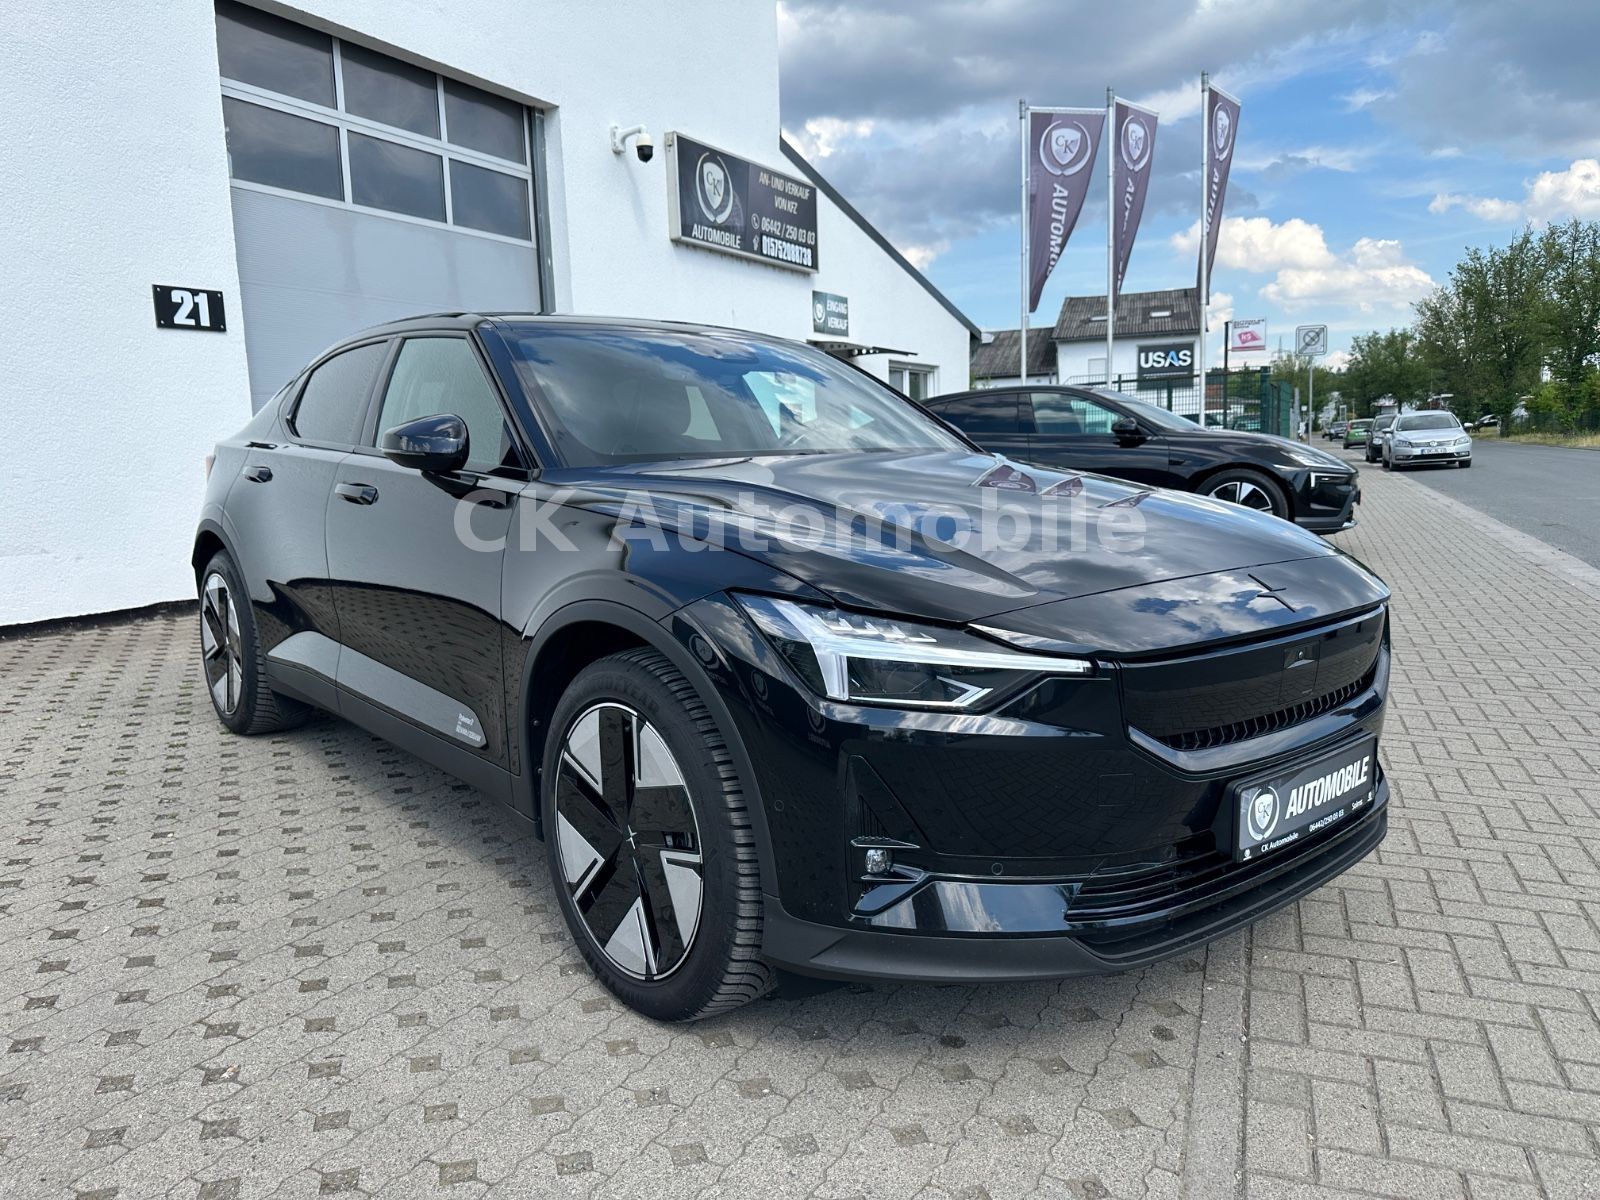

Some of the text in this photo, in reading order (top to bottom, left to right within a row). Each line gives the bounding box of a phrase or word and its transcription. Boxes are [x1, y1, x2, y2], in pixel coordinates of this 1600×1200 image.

[691, 223, 742, 249] AUTOMOBILE
[171, 289, 211, 327] 21
[1140, 350, 1192, 368] USAS
[1285, 755, 1369, 820] AUTOMOBILE
[1261, 832, 1299, 852] CK Automobile
